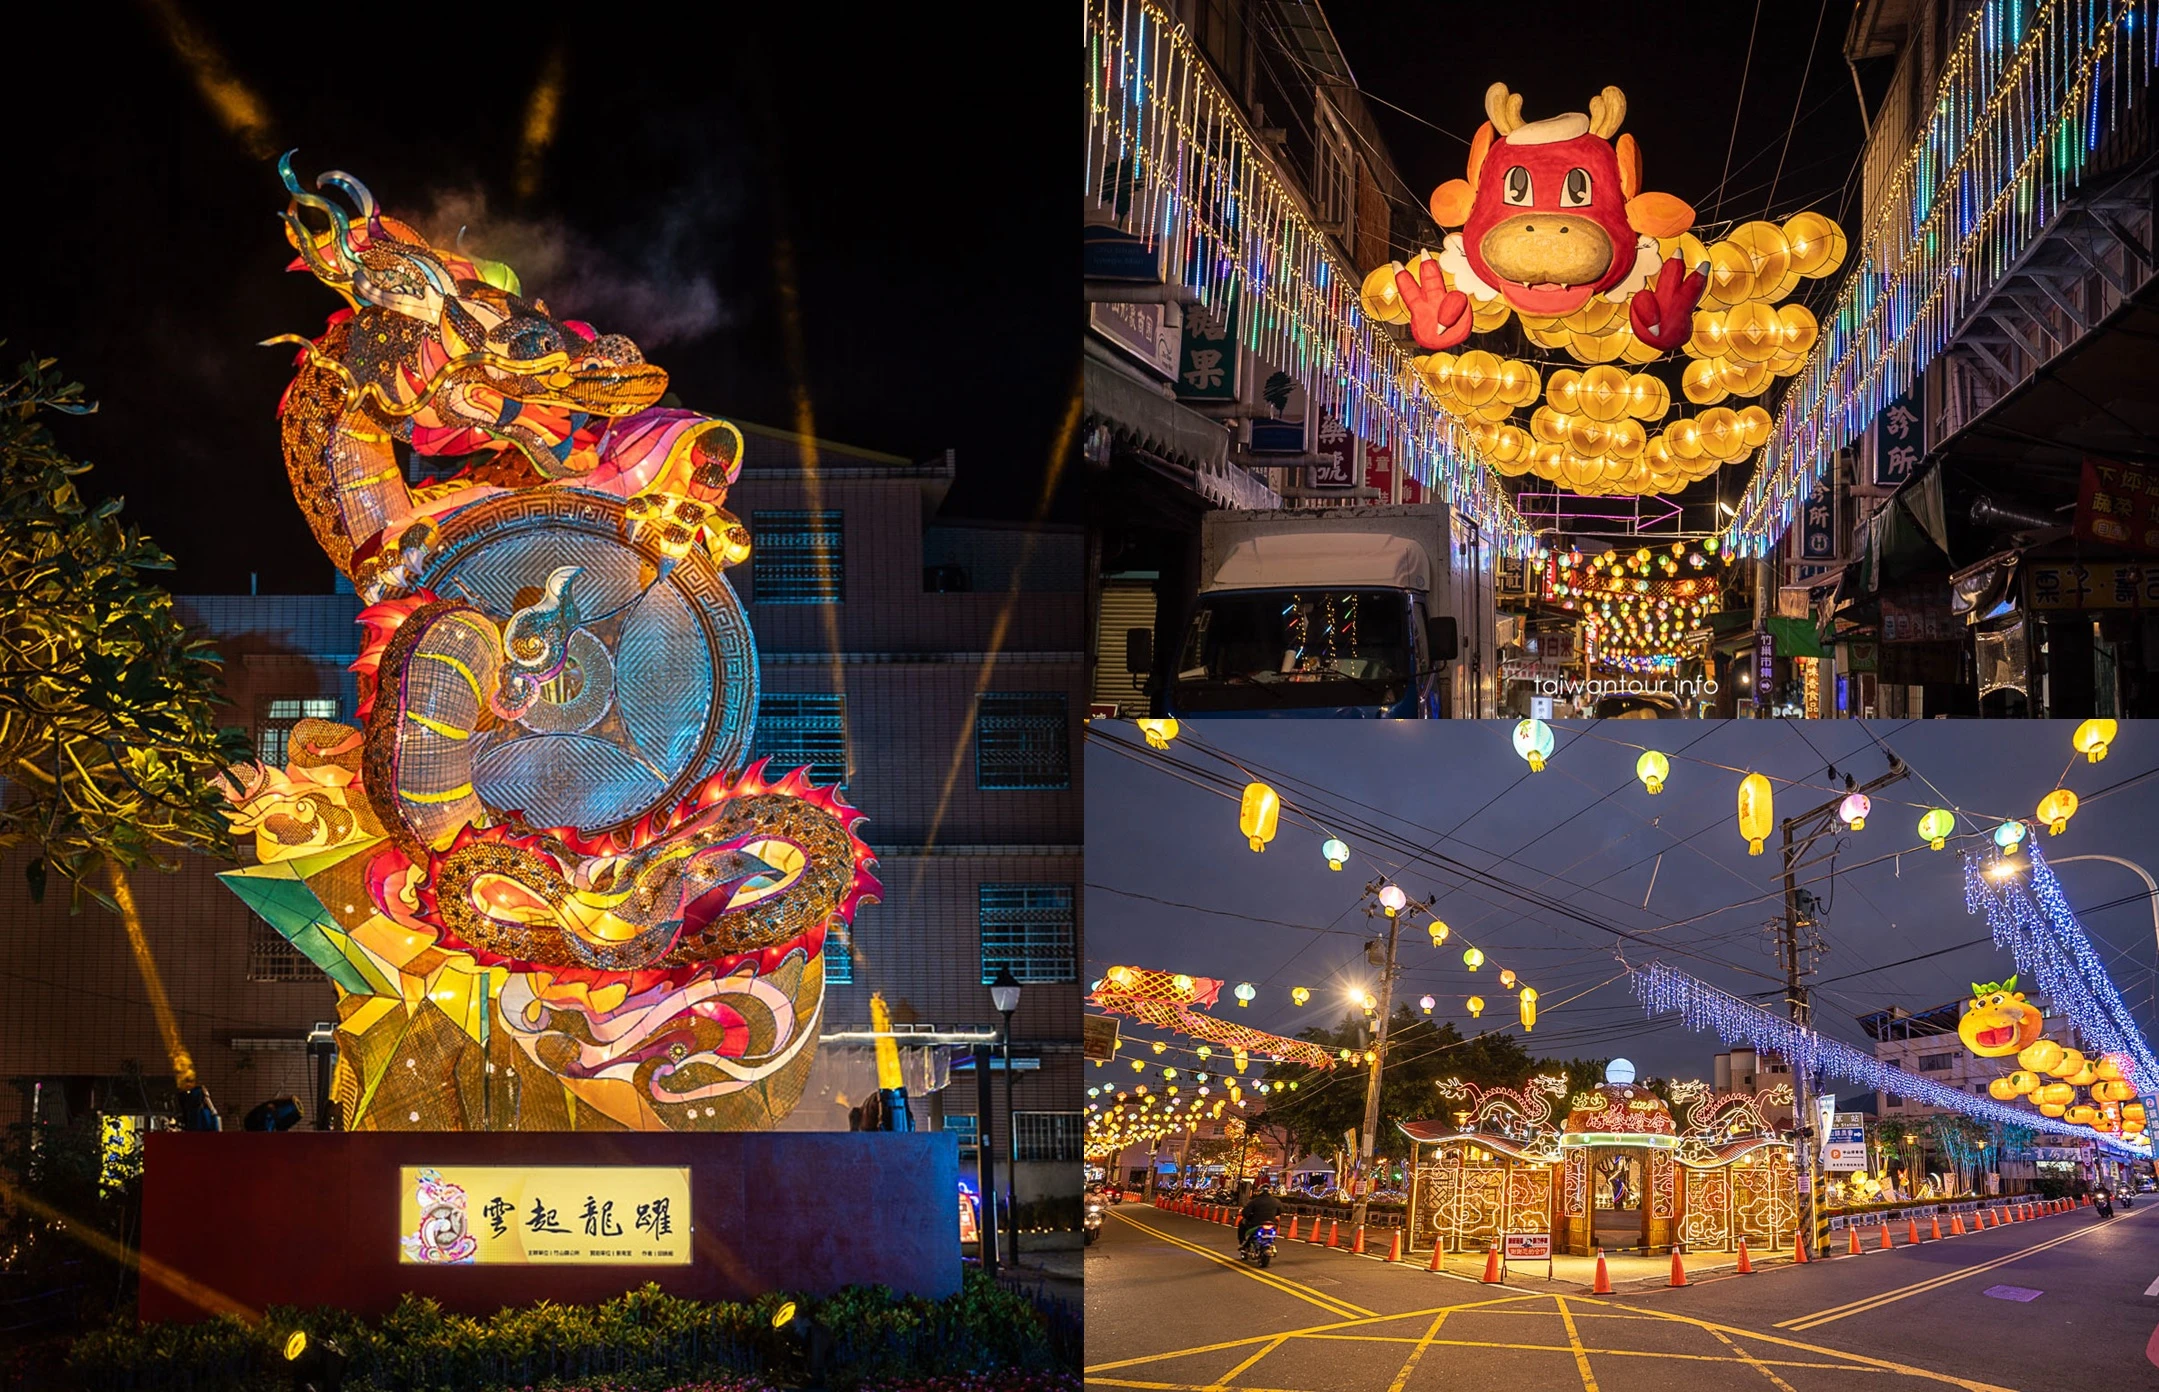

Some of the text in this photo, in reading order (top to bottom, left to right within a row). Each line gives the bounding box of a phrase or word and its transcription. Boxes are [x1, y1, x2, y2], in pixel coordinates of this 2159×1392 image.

[1886, 405, 1919, 475] 診所
[1629, 1100, 1655, 1111] 2024
[482, 1195, 674, 1241] 雲起龍躍
